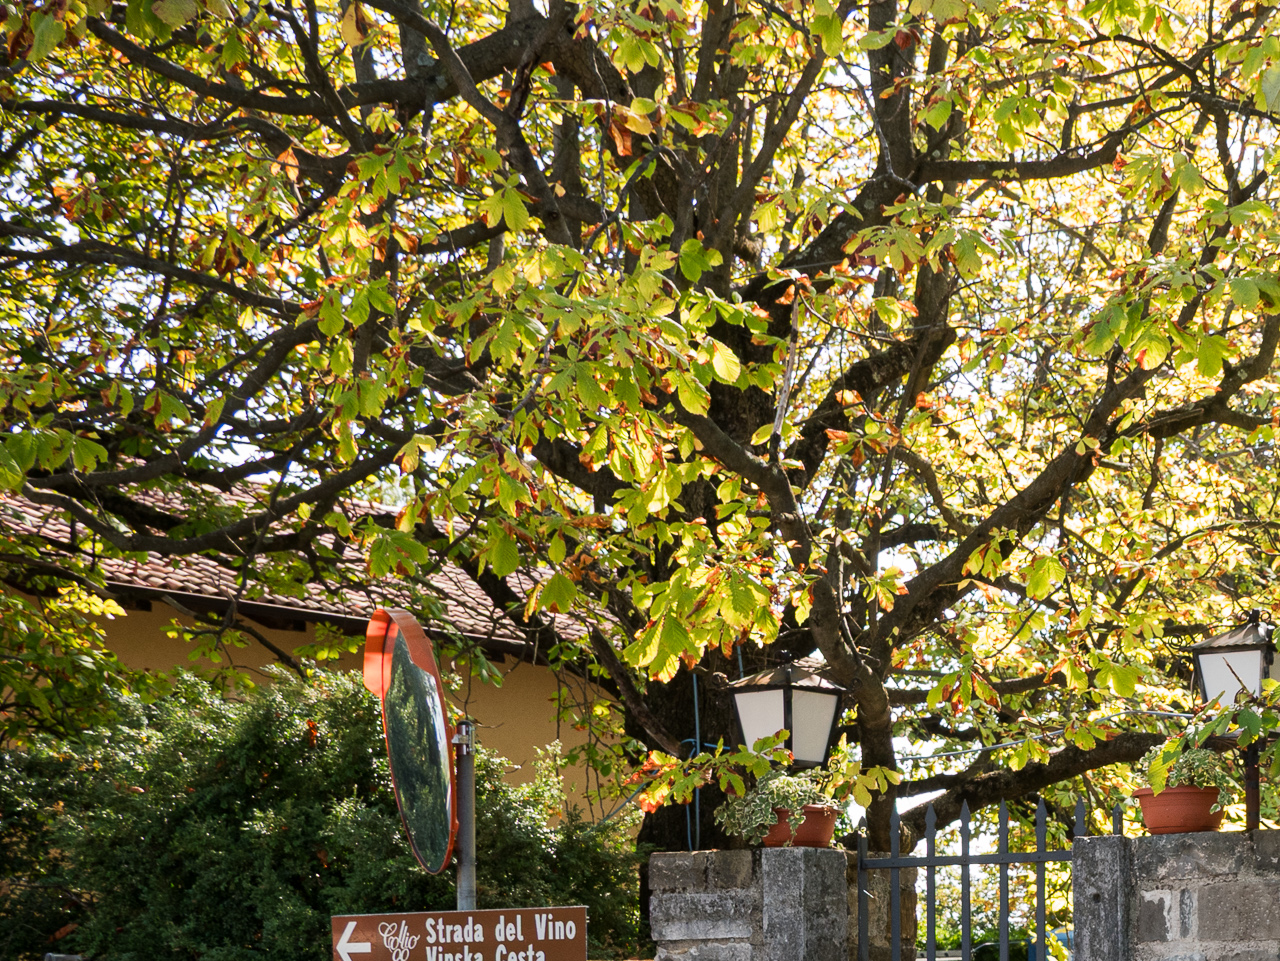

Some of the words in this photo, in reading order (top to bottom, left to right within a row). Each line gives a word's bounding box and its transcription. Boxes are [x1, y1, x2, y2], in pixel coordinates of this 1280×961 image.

[426, 917, 484, 943] Strada
[495, 915, 523, 941] del
[535, 914, 576, 940] Vino
